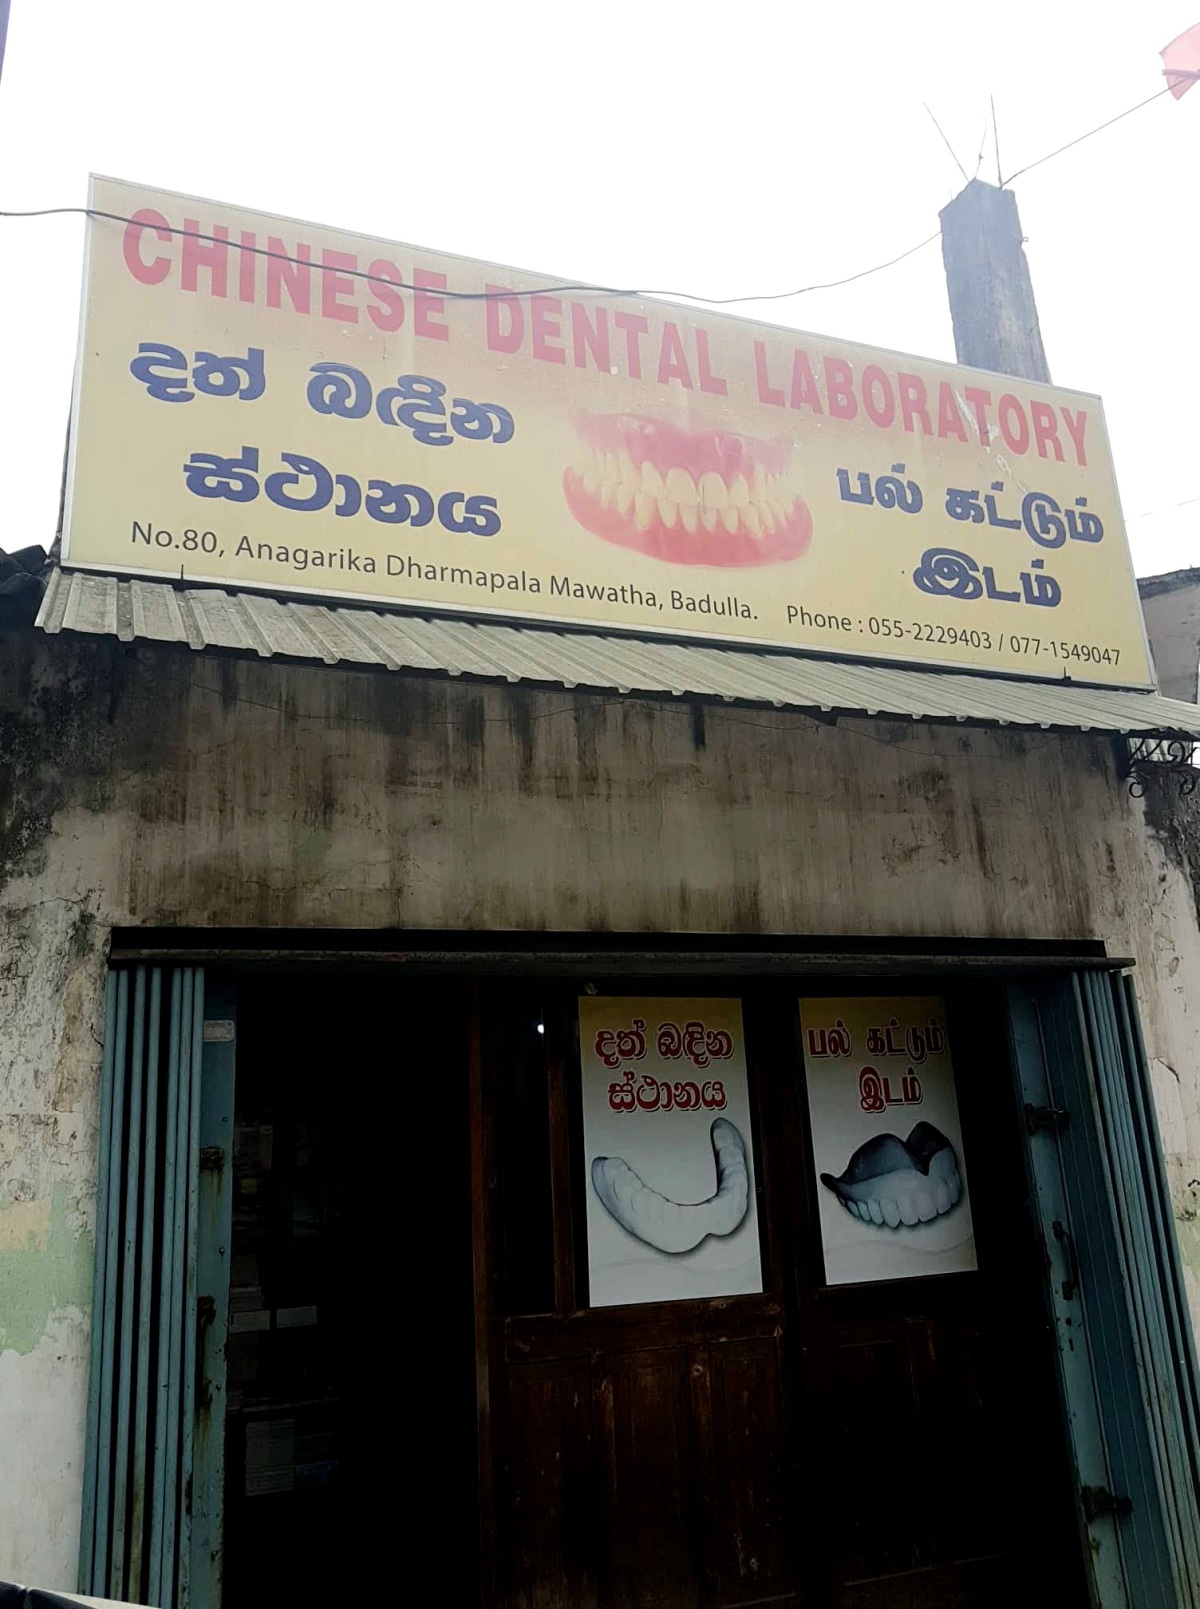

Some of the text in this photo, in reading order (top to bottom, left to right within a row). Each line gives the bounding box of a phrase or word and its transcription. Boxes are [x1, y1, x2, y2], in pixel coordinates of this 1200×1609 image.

[123, 208, 1088, 467] CHINESE DENTAL LABORATORY
[129, 342, 266, 403] දත්
[182, 446, 502, 537] ස්ථානය
[836, 463, 1104, 548] பல் கட்டும்
[131, 521, 225, 558] No.80,
[235, 535, 376, 573] Anagarika
[386, 554, 541, 593] Dharmapala
[550, 575, 663, 611] Mawatha,
[671, 590, 759, 620] Badulla.
[868, 616, 992, 650] 055-2229403
[1009, 635, 1121, 666] 077-1549047
[913, 547, 1062, 608] இடம்
[594, 1019, 645, 1066] දත්
[808, 1016, 944, 1062] பல் கட்டும்
[608, 1071, 727, 1112] ස්ථානය
[858, 1066, 923, 1112] இடம்
